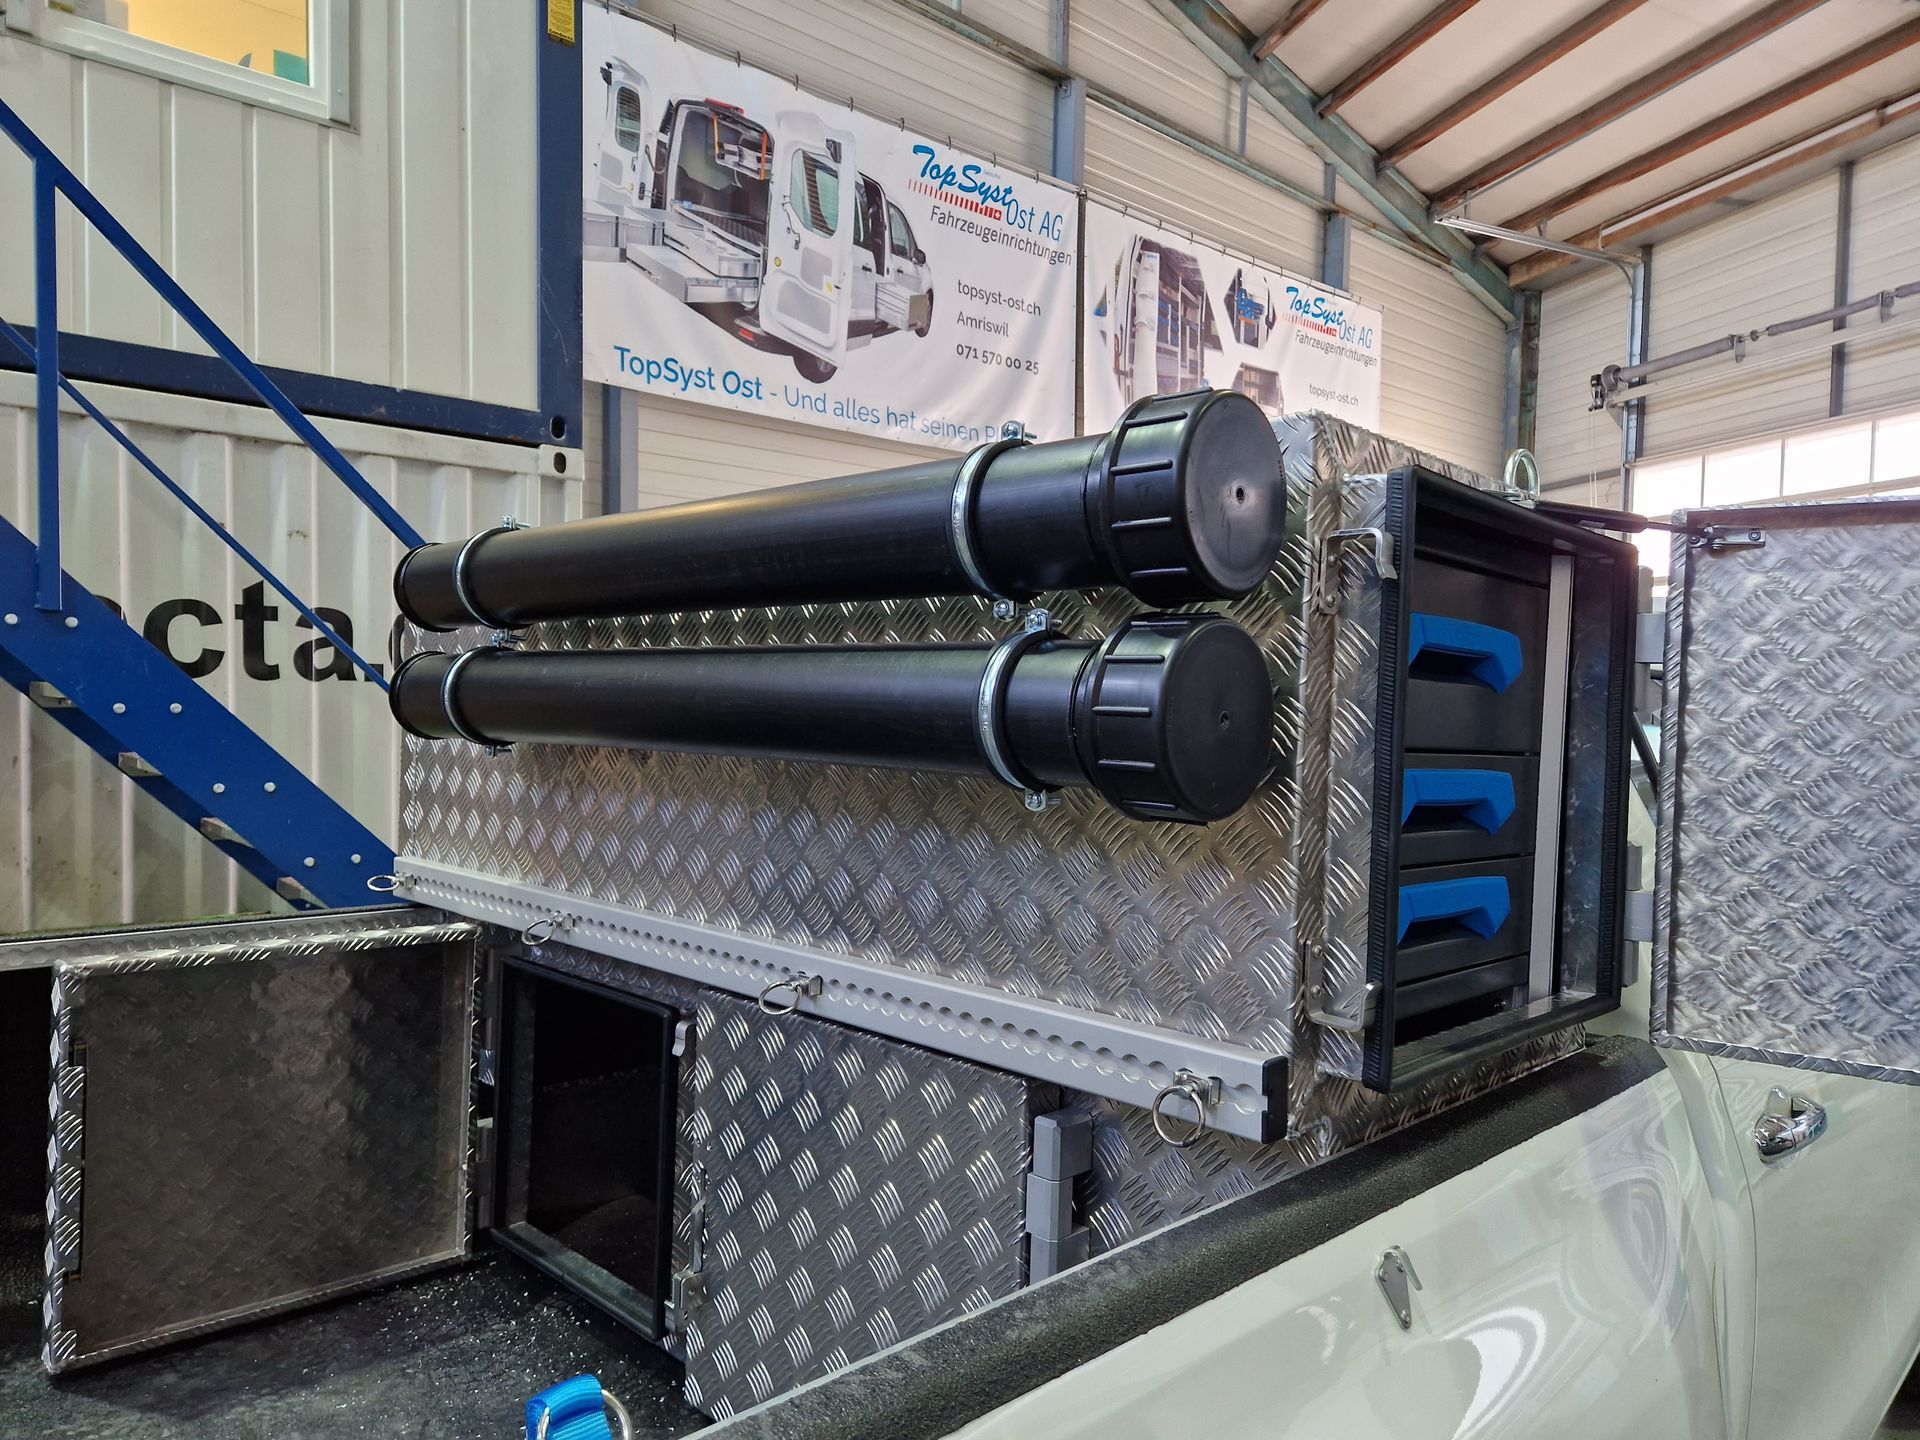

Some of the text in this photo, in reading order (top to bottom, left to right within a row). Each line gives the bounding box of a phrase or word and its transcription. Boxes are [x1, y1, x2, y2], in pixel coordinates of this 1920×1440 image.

[912, 144, 1064, 242] TopSyst Ost AG
[930, 205, 1073, 266] Fahrzeugeinrichtungen
[957, 279, 1041, 316] topsyst-ost.ch
[956, 311, 1009, 338] Amriswil
[1338, 319, 1357, 344] Ost
[1357, 325, 1374, 349] AG
[956, 344, 1040, 375] 071 570 00 25
[1295, 329, 1378, 368] Fahrzeugeinrichtungen
[613, 345, 717, 392] TopSyst
[722, 370, 763, 400] Ost
[784, 384, 827, 414] Und
[833, 397, 881, 425] alles
[886, 405, 917, 431] hat
[920, 416, 979, 443] seinen
[1309, 383, 1360, 407] topsyst-ost.ch
